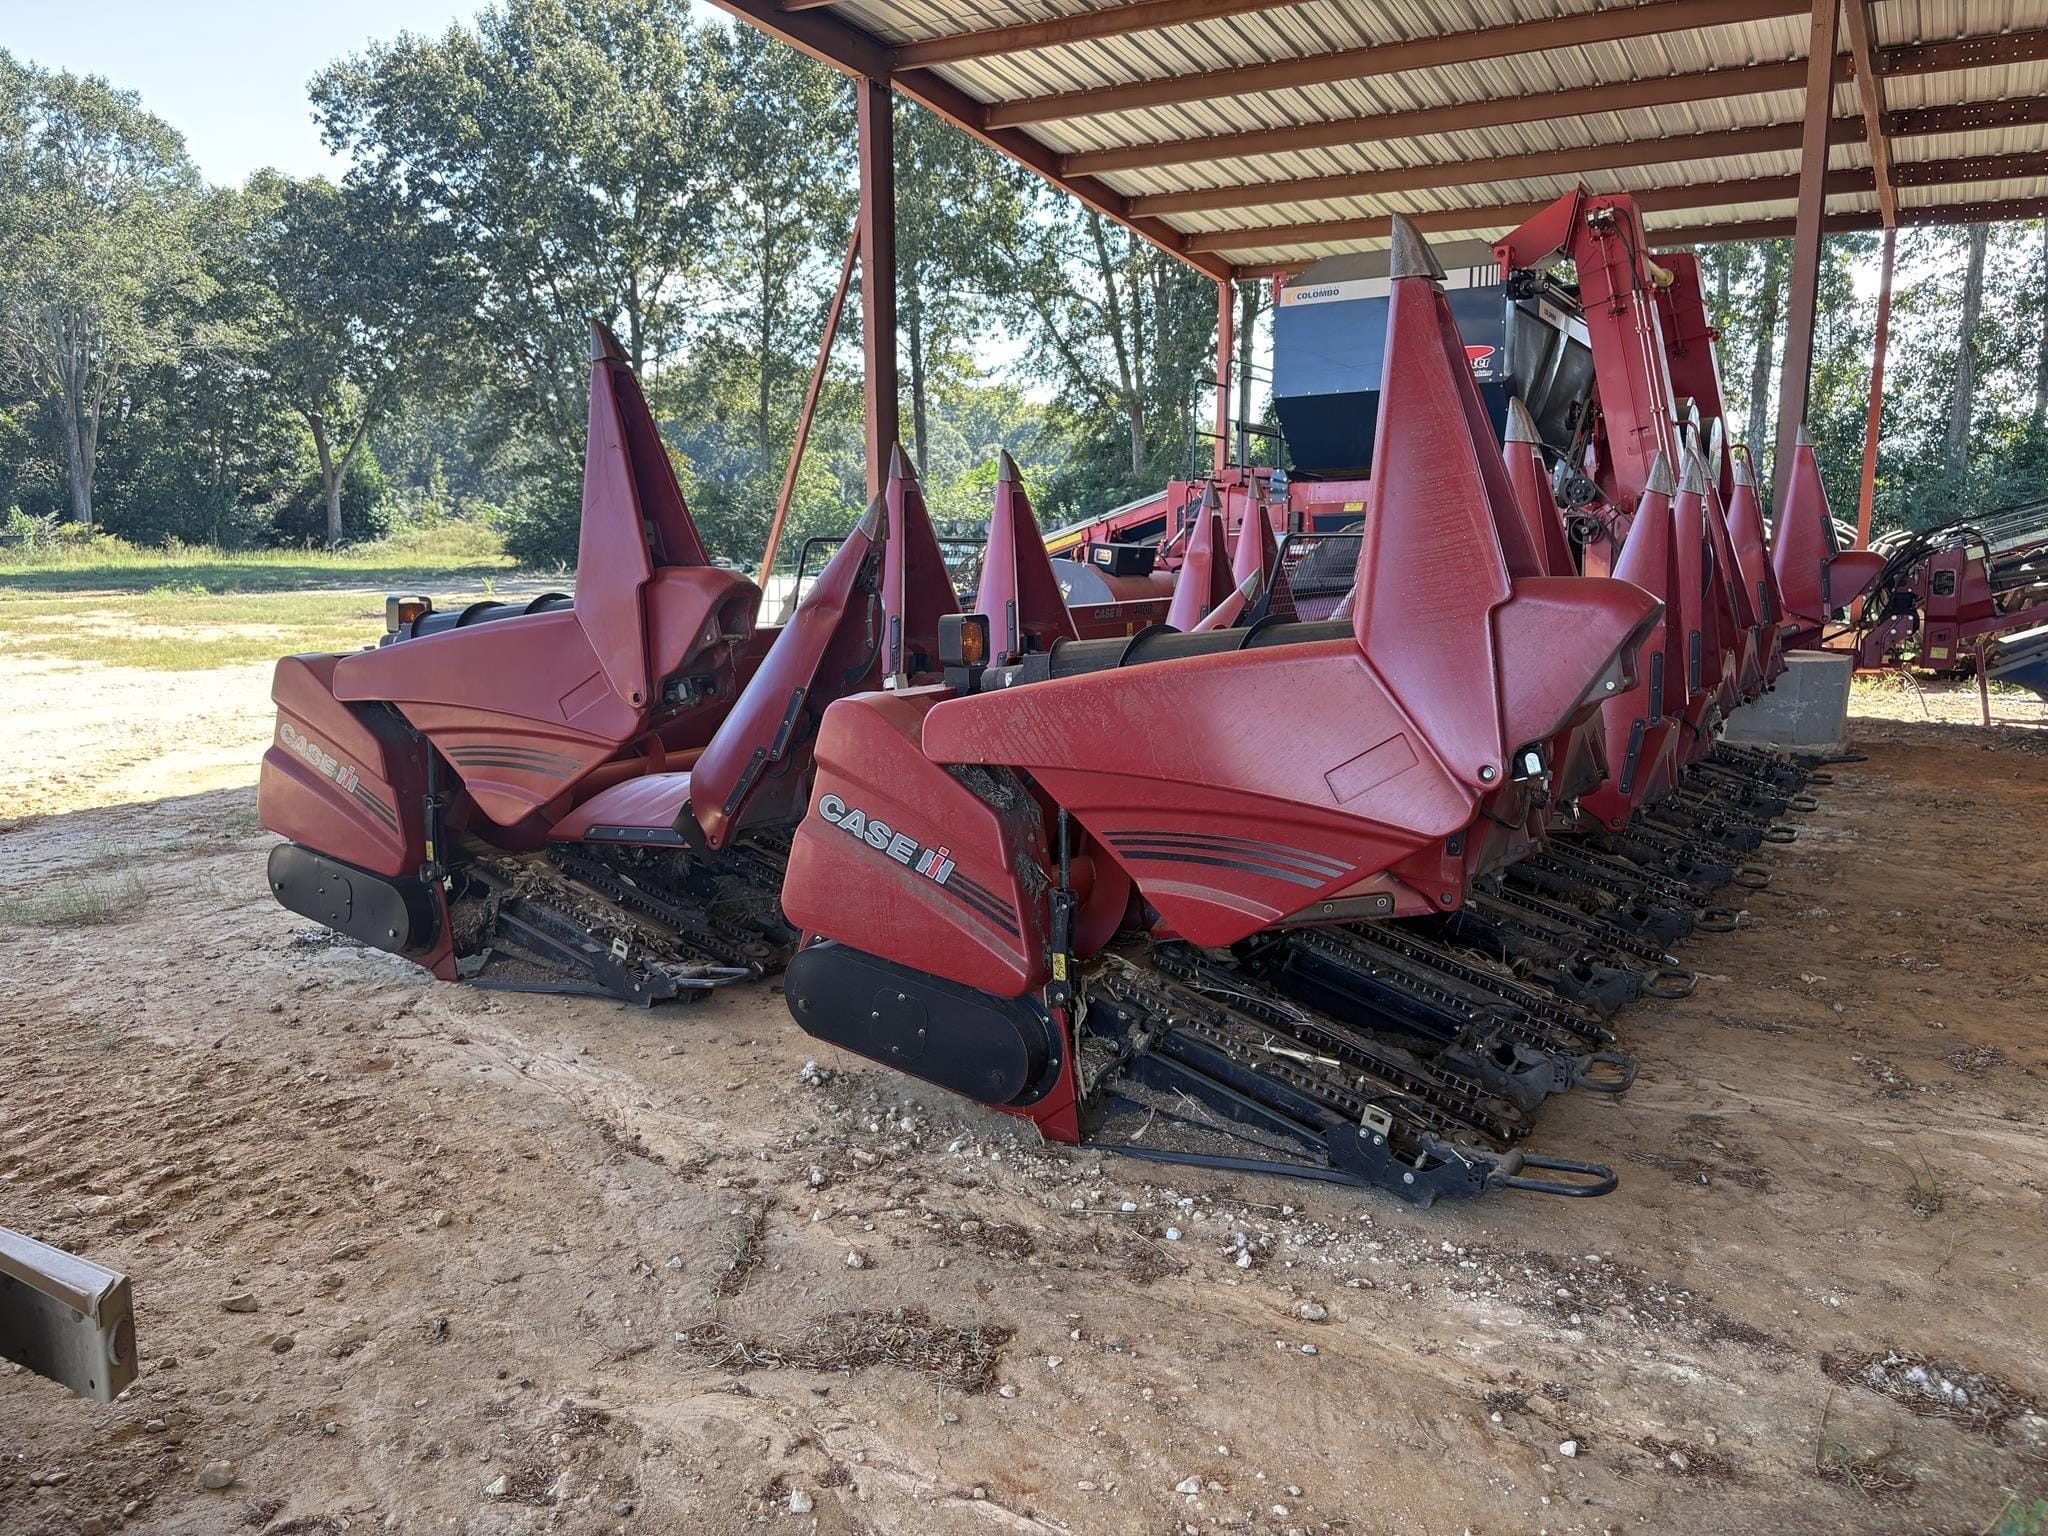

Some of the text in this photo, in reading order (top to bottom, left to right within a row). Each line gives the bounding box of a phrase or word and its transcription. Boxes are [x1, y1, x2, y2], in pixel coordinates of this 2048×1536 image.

[1296, 288, 1340, 300] COLOMBO
[1094, 607, 1116, 619] CASE
[280, 723, 338, 778] CASE
[818, 793, 919, 865] CASE
